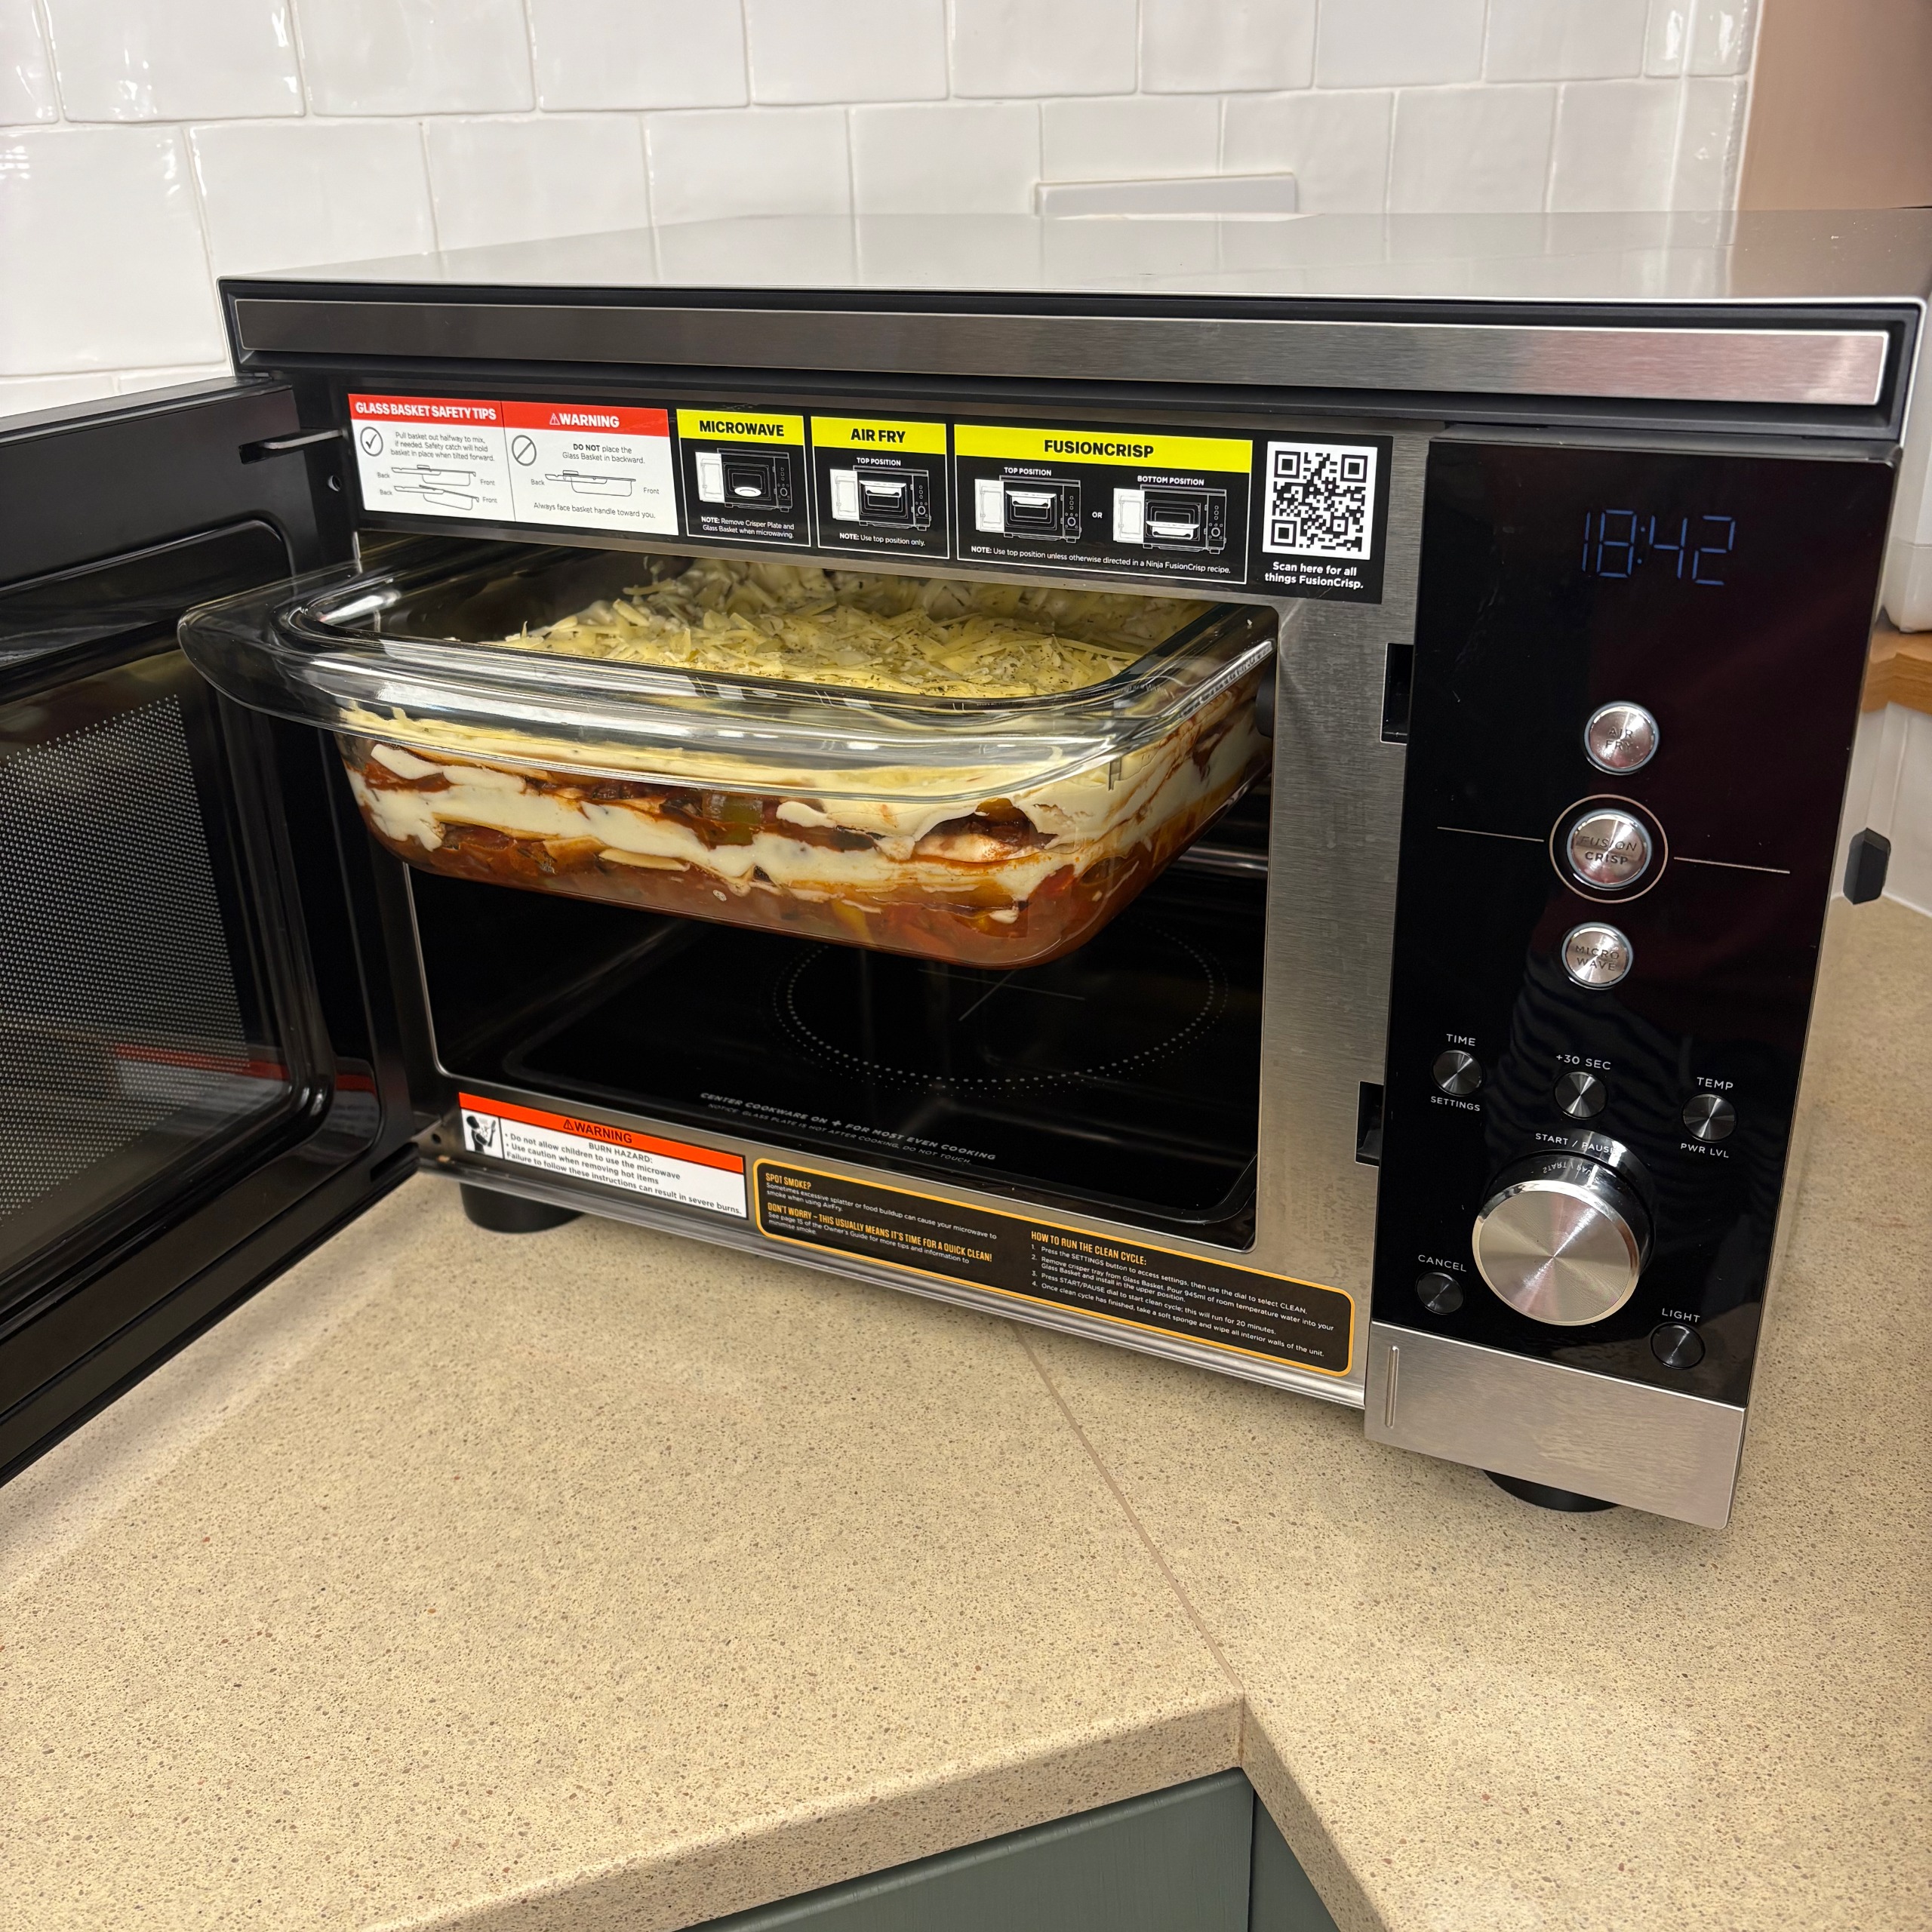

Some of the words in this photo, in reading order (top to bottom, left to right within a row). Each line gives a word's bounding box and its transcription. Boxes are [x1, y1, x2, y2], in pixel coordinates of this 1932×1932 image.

[355, 401, 390, 414] GLASS
[389, 403, 430, 417] BASKET
[430, 405, 471, 419] SAFETY
[471, 407, 497, 420] TIPS
[559, 413, 620, 428] WARNING
[699, 420, 784, 437] MICROWAVE
[850, 428, 875, 441] AIR
[878, 429, 906, 443] FRY
[572, 442, 584, 451] DO
[585, 444, 601, 452] NOT
[620, 446, 632, 454] the
[1044, 438, 1154, 458] FUSIONCRISP
[561, 451, 580, 460] Glass
[580, 452, 602, 461] Basket
[611, 454, 645, 464] backward.
[869, 457, 901, 466] POSITION
[1003, 466, 1018, 474] TOP
[1018, 467, 1052, 476] POSITION
[1137, 475, 1168, 484] BOTTOM
[1168, 476, 1204, 486] POSITION
[642, 486, 660, 494] Front
[533, 502, 556, 511] Always
[556, 503, 571, 512] face
[571, 504, 593, 513] basket
[593, 506, 616, 515] handle
[617, 509, 640, 517] toward
[700, 515, 720, 524] NOTE:
[720, 517, 744, 526] Remove
[745, 519, 766, 528] Crisper
[766, 521, 782, 529] Plate
[718, 525, 738, 534] Basket
[755, 528, 793, 539] microwaving.
[838, 531, 860, 540] NOTE:
[872, 535, 884, 543] top
[910, 539, 925, 547] only.
[1581, 509, 1736, 586] 18:42
[971, 545, 992, 554] NOTE:
[1006, 549, 1018, 557] top
[1046, 552, 1067, 560] unless
[1068, 554, 1102, 563] otherwise
[1102, 556, 1131, 565] directed
[1145, 559, 1164, 569] Ninja
[1164, 561, 1206, 572] FusionCrisp
[1207, 565, 1231, 574] recipe.
[1272, 561, 1297, 571] Scan
[1300, 562, 1324, 574] here
[1325, 565, 1342, 575] for
[1343, 566, 1357, 576] all
[1264, 571, 1297, 584] things
[1298, 574, 1364, 589] FusionCrisp.
[1607, 727, 1634, 739] AIR
[1604, 740, 1633, 751] FRY
[1580, 835, 1638, 852] FUSION
[1584, 851, 1629, 865] CRISP
[1575, 945, 1620, 960] MICRO
[1577, 957, 1616, 971] WAVE
[1445, 1032, 1475, 1047] TIME
[1555, 1054, 1580, 1065] +30
[1584, 1057, 1611, 1070] SEC
[1696, 1076, 1734, 1090] TEMP
[1430, 1095, 1480, 1112] SETTINGS
[574, 1120, 632, 1143] WARNING
[700, 1092, 743, 1106] CENTER
[744, 1102, 808, 1119] COOKWARE
[811, 1115, 828, 1124] ON
[844, 1123, 870, 1133] FOR
[871, 1128, 905, 1140] MOST
[906, 1136, 938, 1147] EVEN
[940, 1143, 995, 1160] COOKING
[1535, 1132, 1568, 1145] START
[509, 1132, 521, 1142] Do
[523, 1137, 537, 1146] not
[538, 1140, 559, 1151] allow
[561, 1146, 593, 1159] children
[594, 1153, 604, 1161] to
[605, 1157, 620, 1165] use
[621, 1159, 635, 1169] the
[636, 1164, 681, 1180] microwave
[588, 1142, 612, 1154] BURN
[614, 1148, 653, 1164] HAZARD:
[1680, 1142, 1706, 1154] PWR
[1709, 1147, 1729, 1158] LVL
[511, 1142, 525, 1152] Use
[527, 1147, 556, 1160] caution
[558, 1155, 580, 1165] when
[581, 1161, 619, 1176] removing
[620, 1168, 635, 1179] hot
[506, 1150, 532, 1163] Failure
[543, 1160, 567, 1171] follow
[568, 1166, 589, 1177] these
[591, 1171, 637, 1189] instructions
[638, 1184, 653, 1192] can
[654, 1188, 677, 1199] result
[678, 1192, 687, 1201] in
[688, 1196, 715, 1208] severe
[715, 1201, 742, 1214] burns.
[764, 1172, 783, 1184] SPOT
[783, 1176, 811, 1190] SMOKE?
[767, 1201, 786, 1214] DON'T
[787, 1206, 812, 1220] WORRY
[818, 1213, 834, 1225] THIS
[835, 1217, 864, 1232] USUALLY
[864, 1224, 890, 1238] MEANS
[891, 1229, 903, 1241] IT'S
[904, 1233, 921, 1245] TIME
[922, 1237, 937, 1249] FOR
[937, 1241, 943, 1251] A
[943, 1242, 966, 1256] QUICK
[967, 1247, 992, 1262] CLEAN!
[1030, 1230, 1049, 1243] HOW
[1049, 1234, 1060, 1245] TO
[1060, 1237, 1077, 1250] RUN
[1078, 1241, 1093, 1253] THE
[1094, 1244, 1119, 1259] CLEAN
[1120, 1251, 1146, 1266] CYCLE:
[1417, 1254, 1466, 1272] CANCEL
[1041, 1245, 1058, 1255] Press
[1071, 1253, 1104, 1266] SETTINGS
[1105, 1260, 1128, 1271] button
[1137, 1269, 1159, 1279] access
[1161, 1275, 1189, 1286] settings,
[1190, 1281, 1206, 1290] then
[1220, 1288, 1232, 1297] the
[1233, 1291, 1247, 1300] dial
[1257, 1297, 1278, 1308] select
[1279, 1302, 1306, 1314] CLEAN.
[1661, 1307, 1700, 1323] LIGHT
